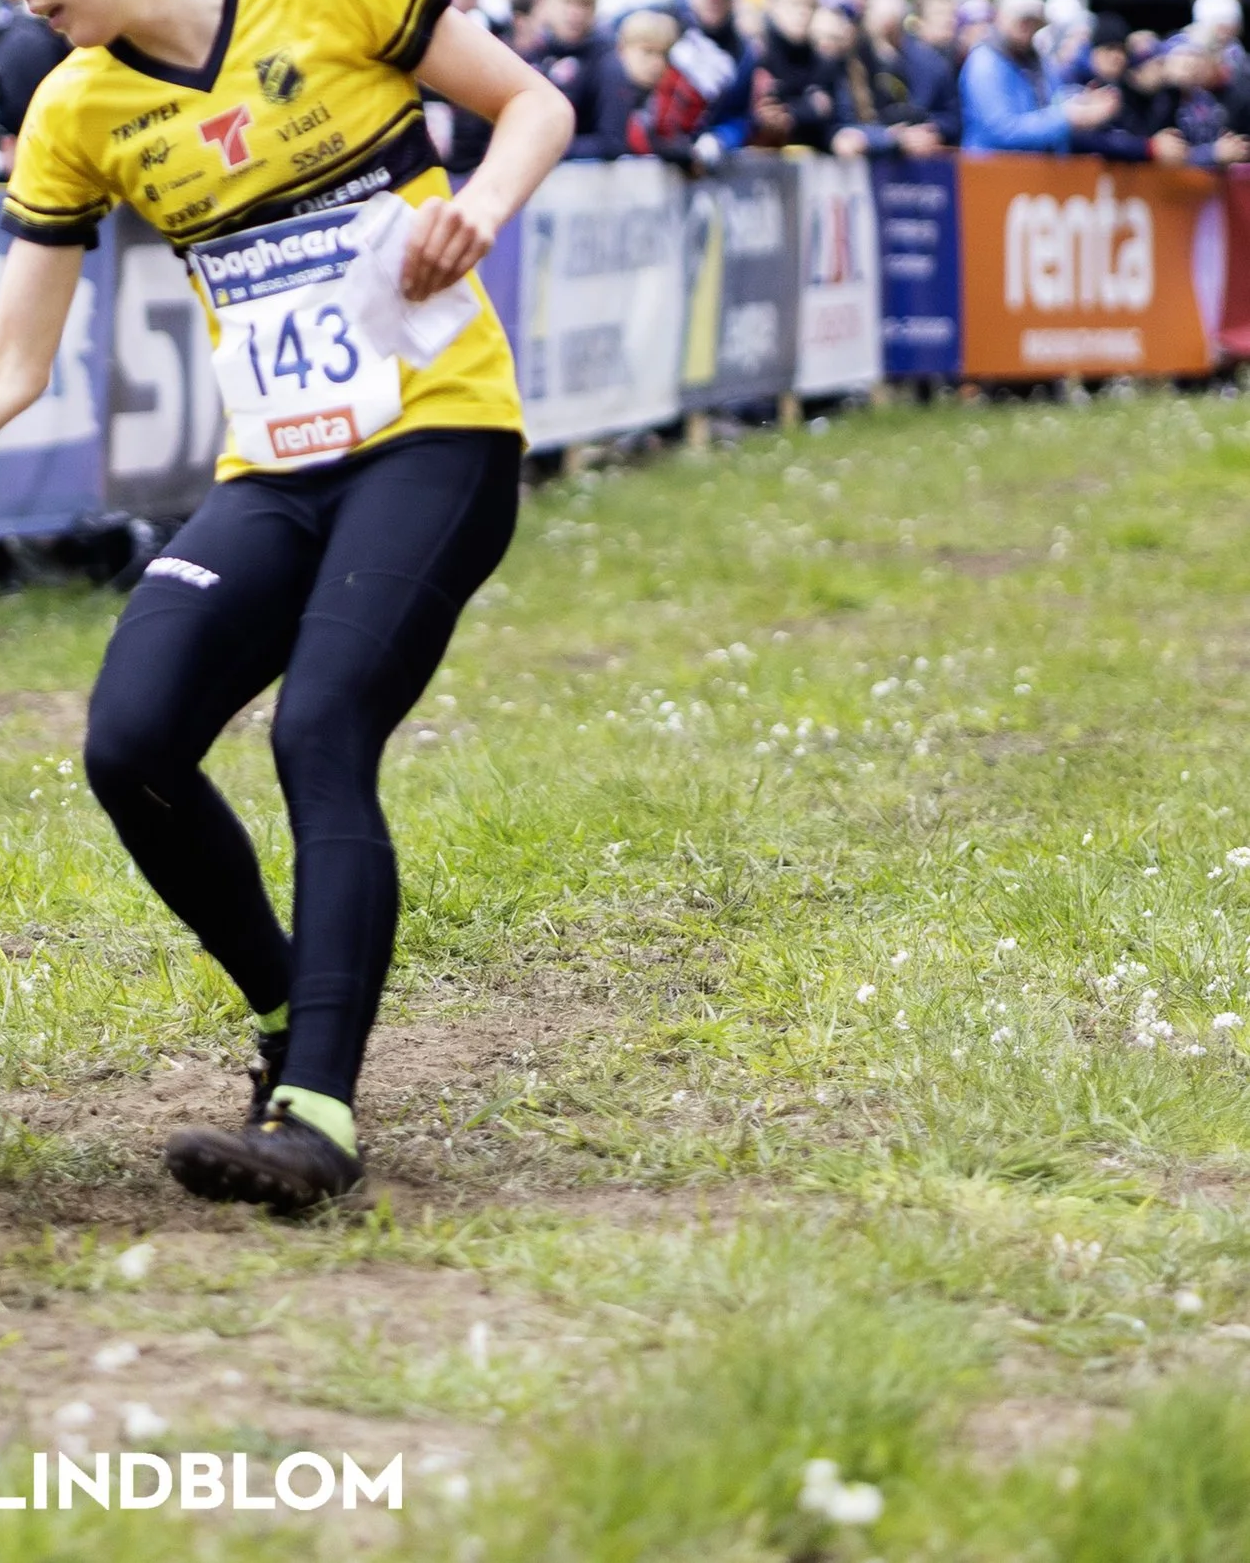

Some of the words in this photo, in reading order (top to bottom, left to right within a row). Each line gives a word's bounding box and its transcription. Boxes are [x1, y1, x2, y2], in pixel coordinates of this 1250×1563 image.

[290, 131, 346, 172] SSAB
[1003, 175, 1155, 312] renta
[249, 303, 359, 396] 143
[273, 415, 351, 451] renta
